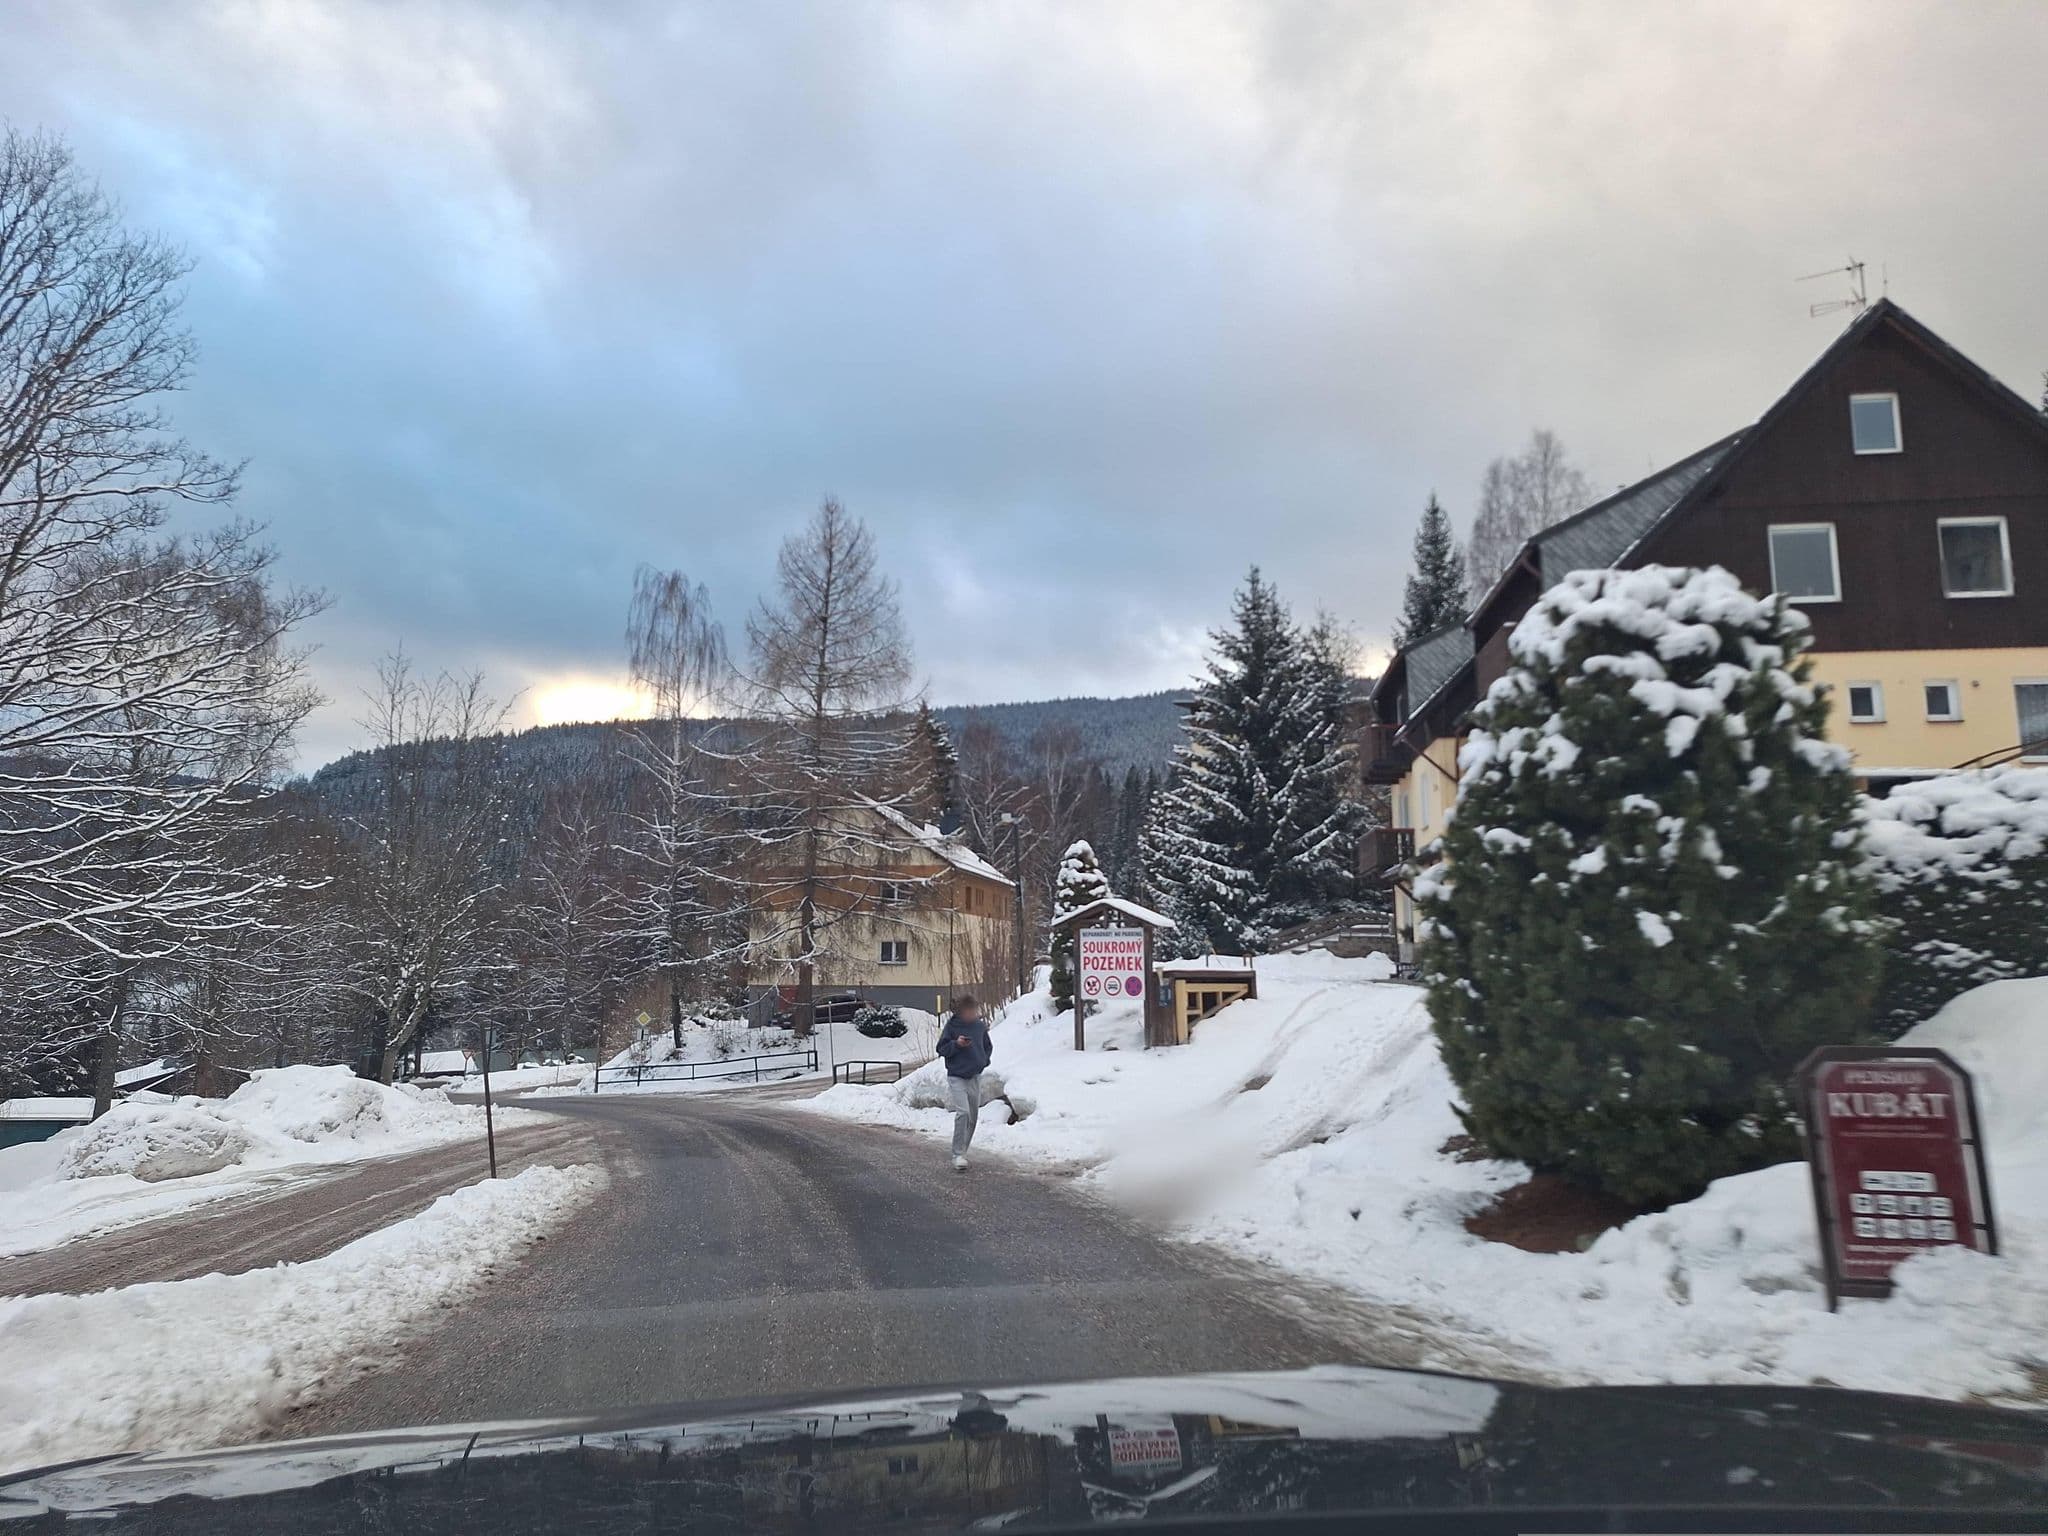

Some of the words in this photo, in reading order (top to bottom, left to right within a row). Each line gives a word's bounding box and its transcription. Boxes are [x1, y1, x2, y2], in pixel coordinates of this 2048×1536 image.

[1083, 938, 1142, 953] SOUKROMÝ
[1083, 956, 1142, 971] POZEMEK
[1828, 1087, 1951, 1118] KUBÁT
